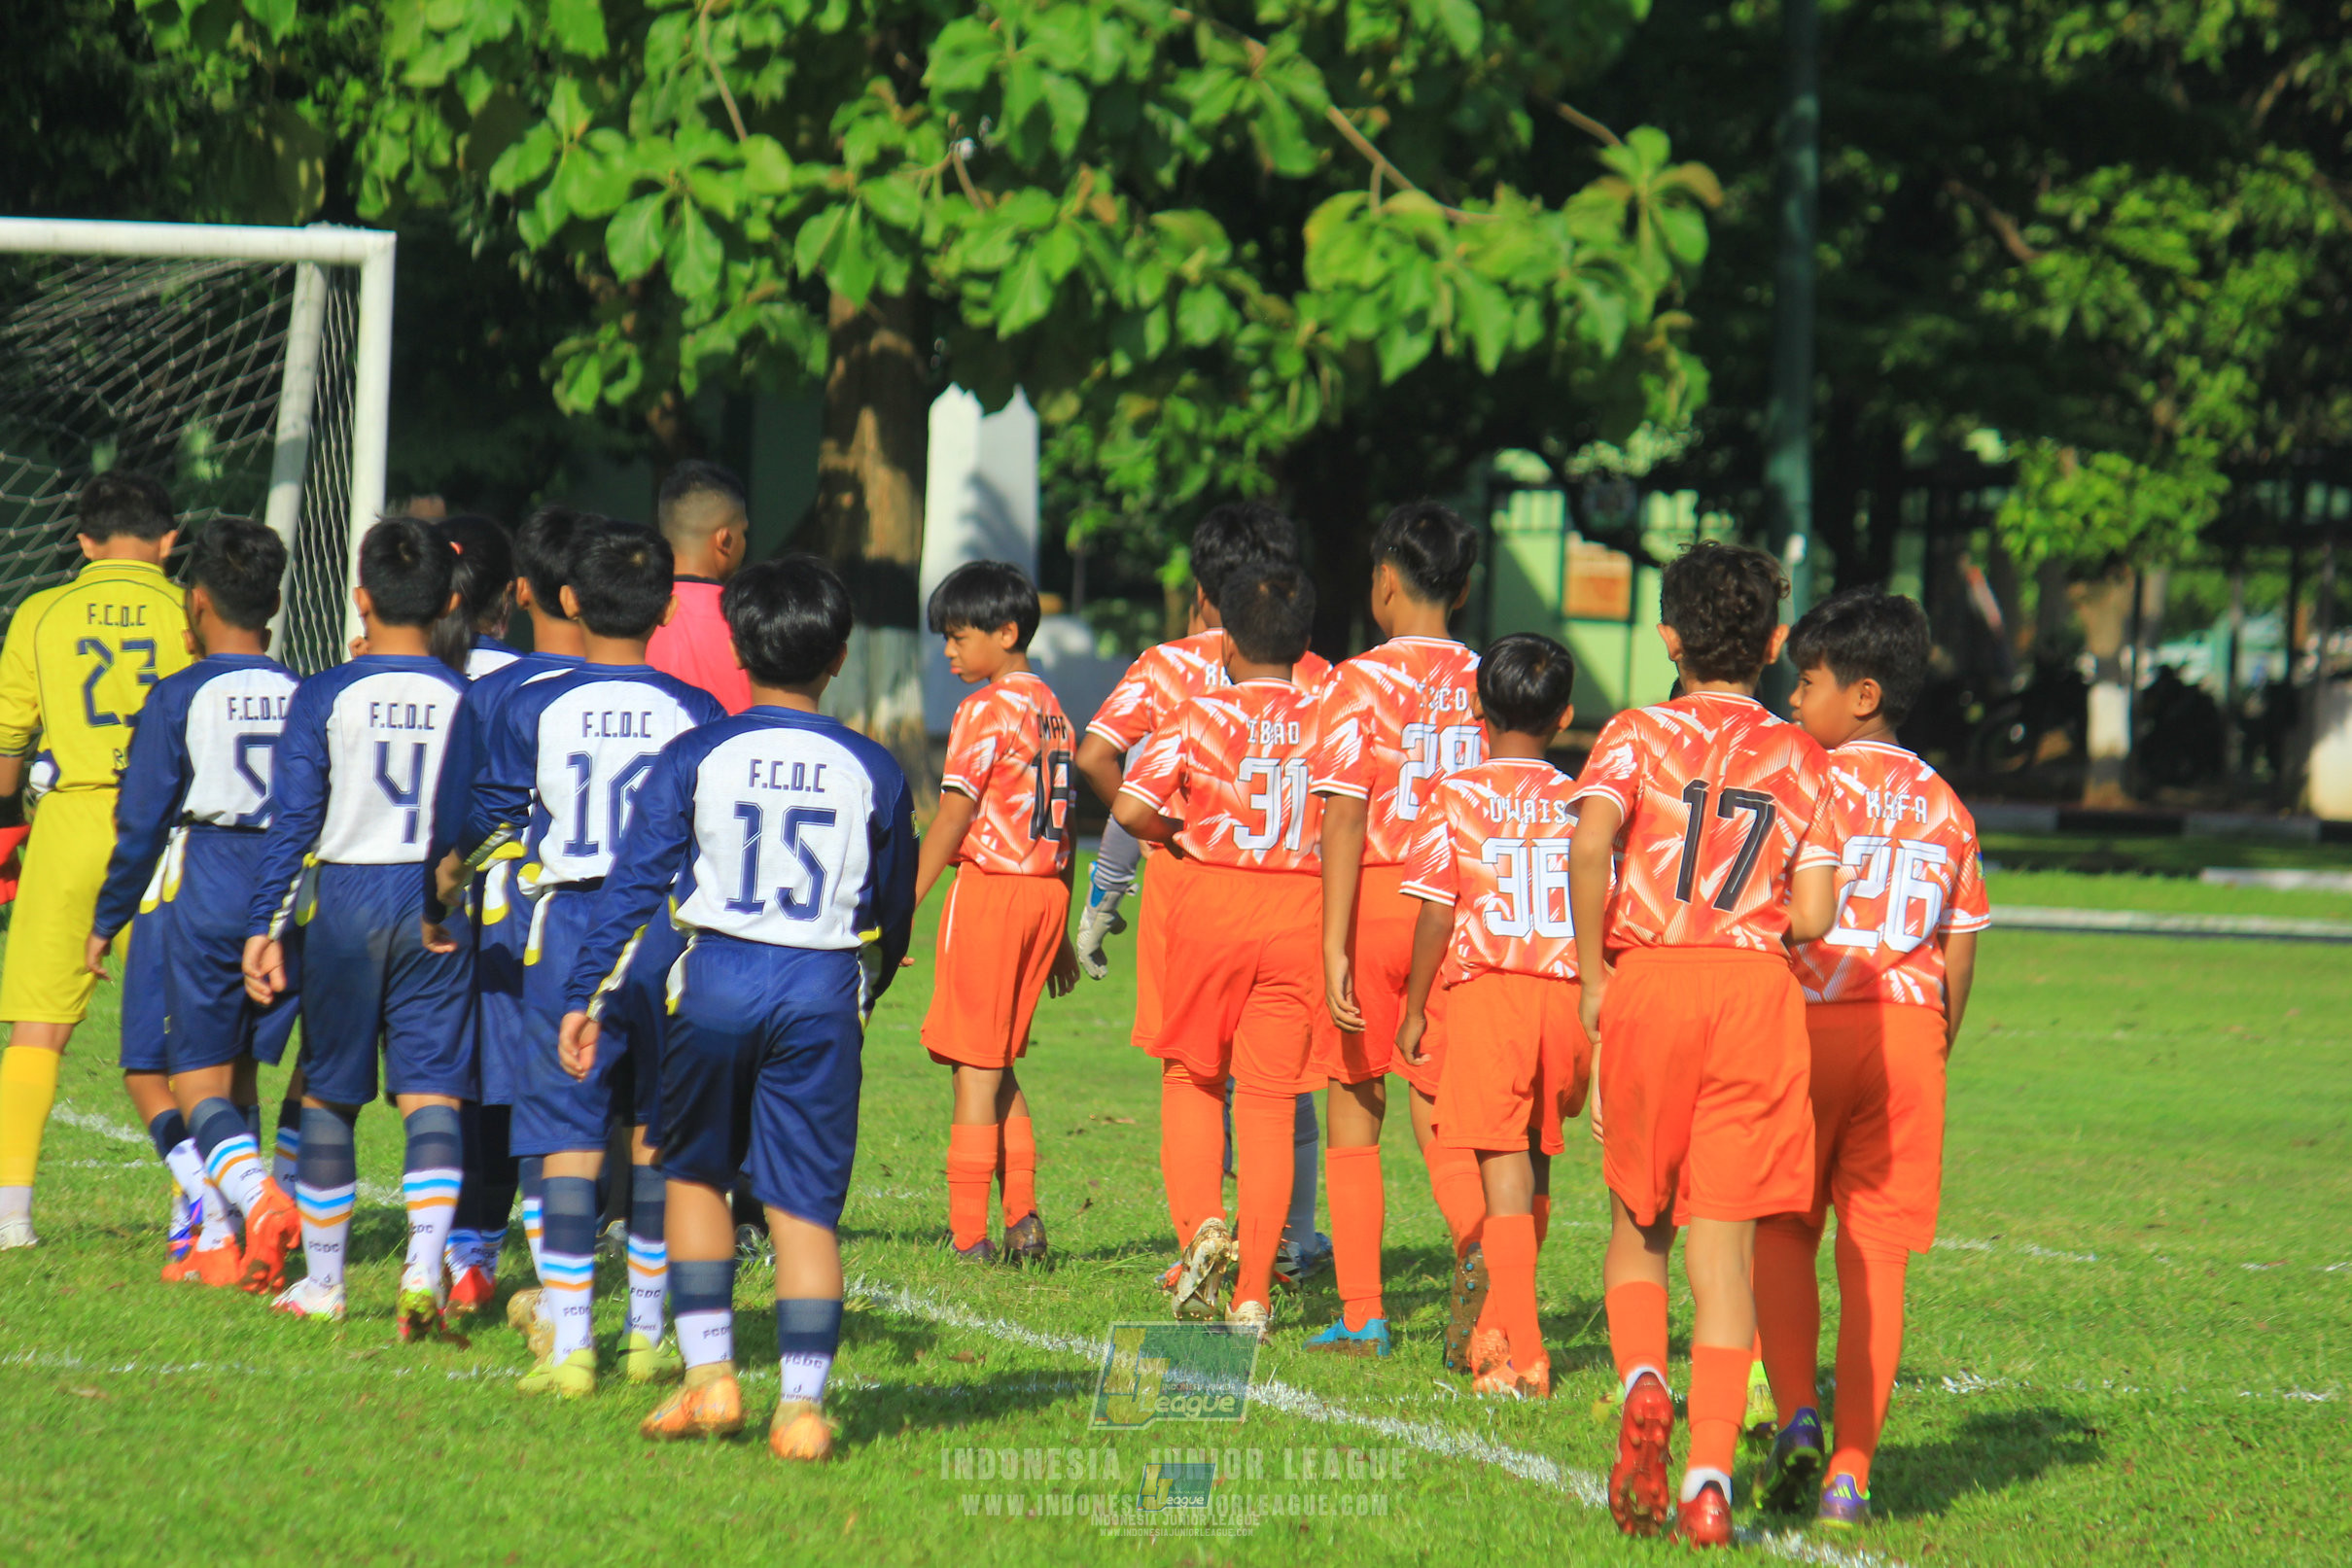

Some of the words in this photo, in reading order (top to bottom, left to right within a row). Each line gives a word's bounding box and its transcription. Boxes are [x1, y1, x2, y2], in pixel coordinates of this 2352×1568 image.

[372, 740, 428, 845] 4
[1231, 755, 1309, 852] 31
[1674, 778, 1776, 913] 17
[722, 800, 837, 923] 15
[1480, 836, 1576, 938] 36
[1822, 834, 1948, 954] 26
